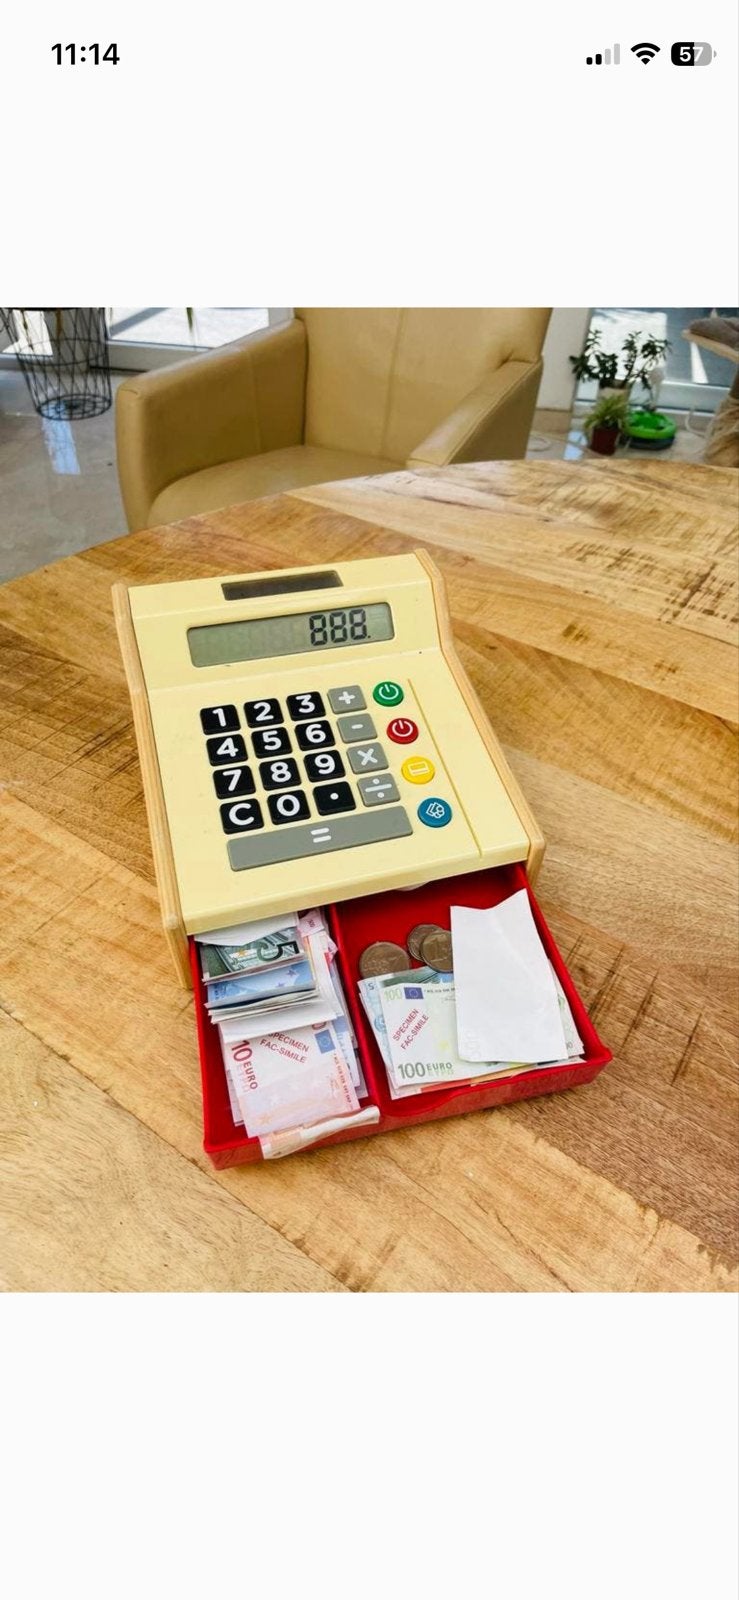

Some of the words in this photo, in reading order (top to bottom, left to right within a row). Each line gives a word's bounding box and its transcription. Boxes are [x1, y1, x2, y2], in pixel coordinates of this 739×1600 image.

[213, 709, 226, 726] 1
[254, 702, 273, 721] 2
[296, 695, 314, 712] 3
[216, 736, 238, 756] 4
[263, 731, 281, 750] 5
[306, 724, 325, 742] 6
[223, 770, 241, 790] 7
[271, 762, 291, 782] 8
[315, 755, 335, 774] 9
[228, 802, 254, 825] C
[384, 988, 402, 1001] 100
[392, 1008, 419, 1042] SPECIMEN
[400, 1014, 430, 1051] FAC-SIMILE
[231, 1040, 252, 1062] 10
[243, 1061, 259, 1090] EURO
[260, 1038, 308, 1063] FAC-SIMILE
[398, 1062, 426, 1079] 100
[426, 1062, 453, 1071] EURO
